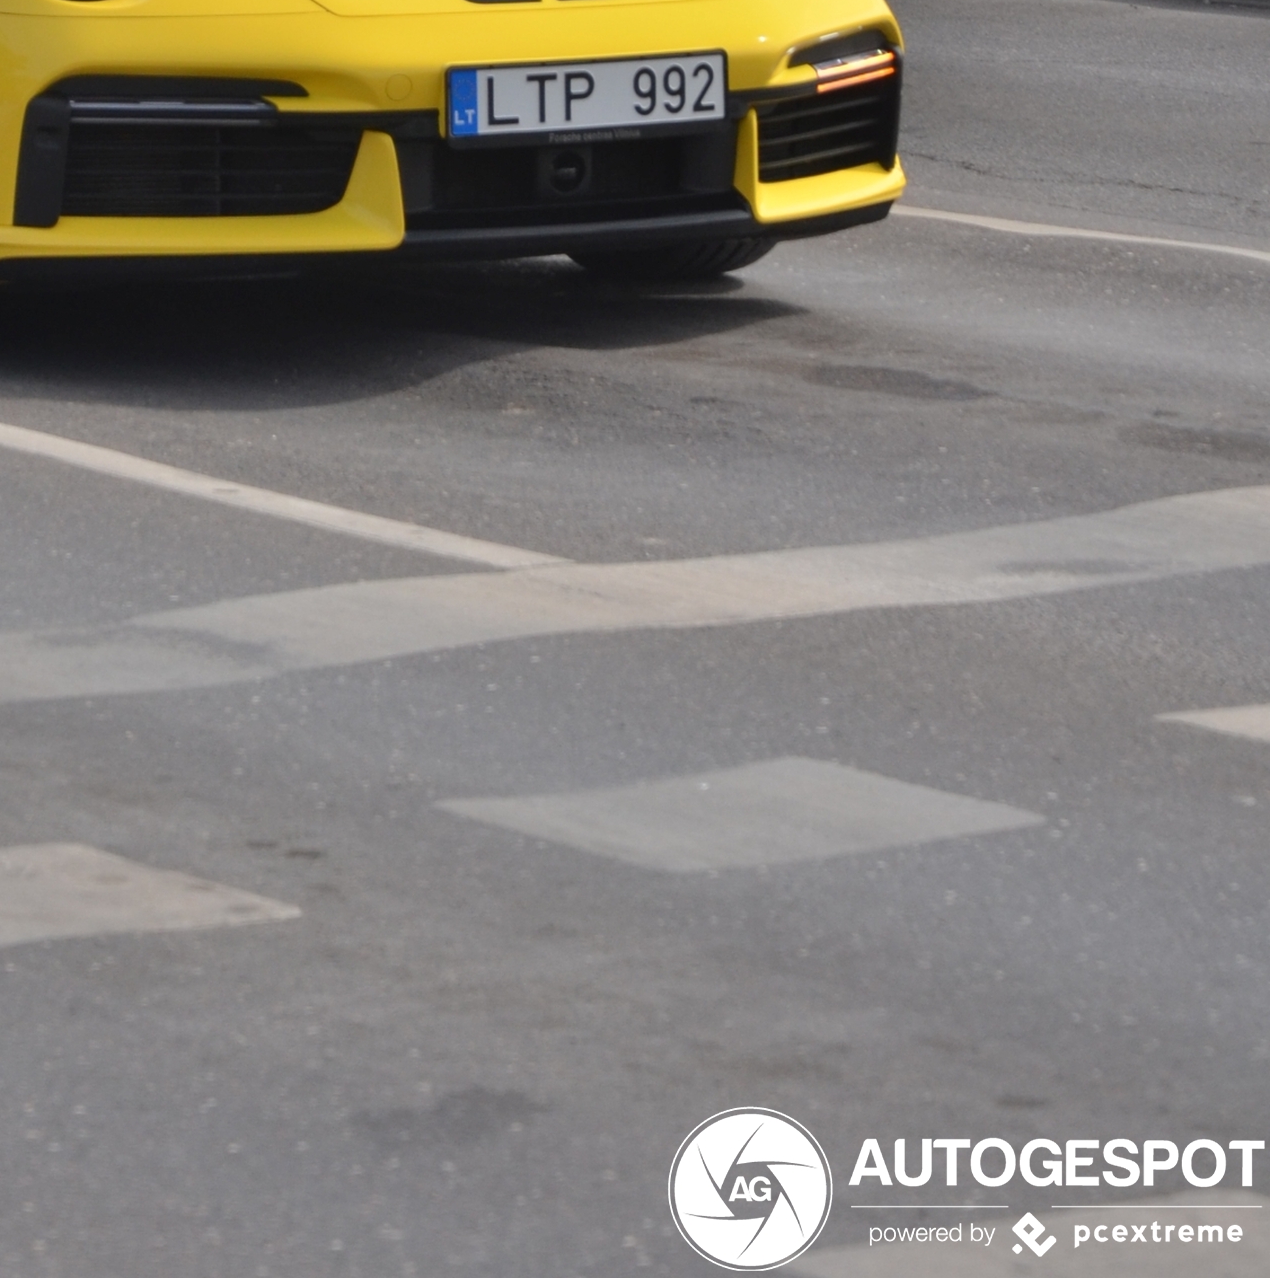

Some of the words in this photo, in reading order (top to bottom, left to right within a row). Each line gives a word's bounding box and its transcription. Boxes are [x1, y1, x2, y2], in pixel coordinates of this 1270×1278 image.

[487, 71, 595, 126] LTP
[633, 62, 716, 116] 992
[454, 109, 475, 125] LT
